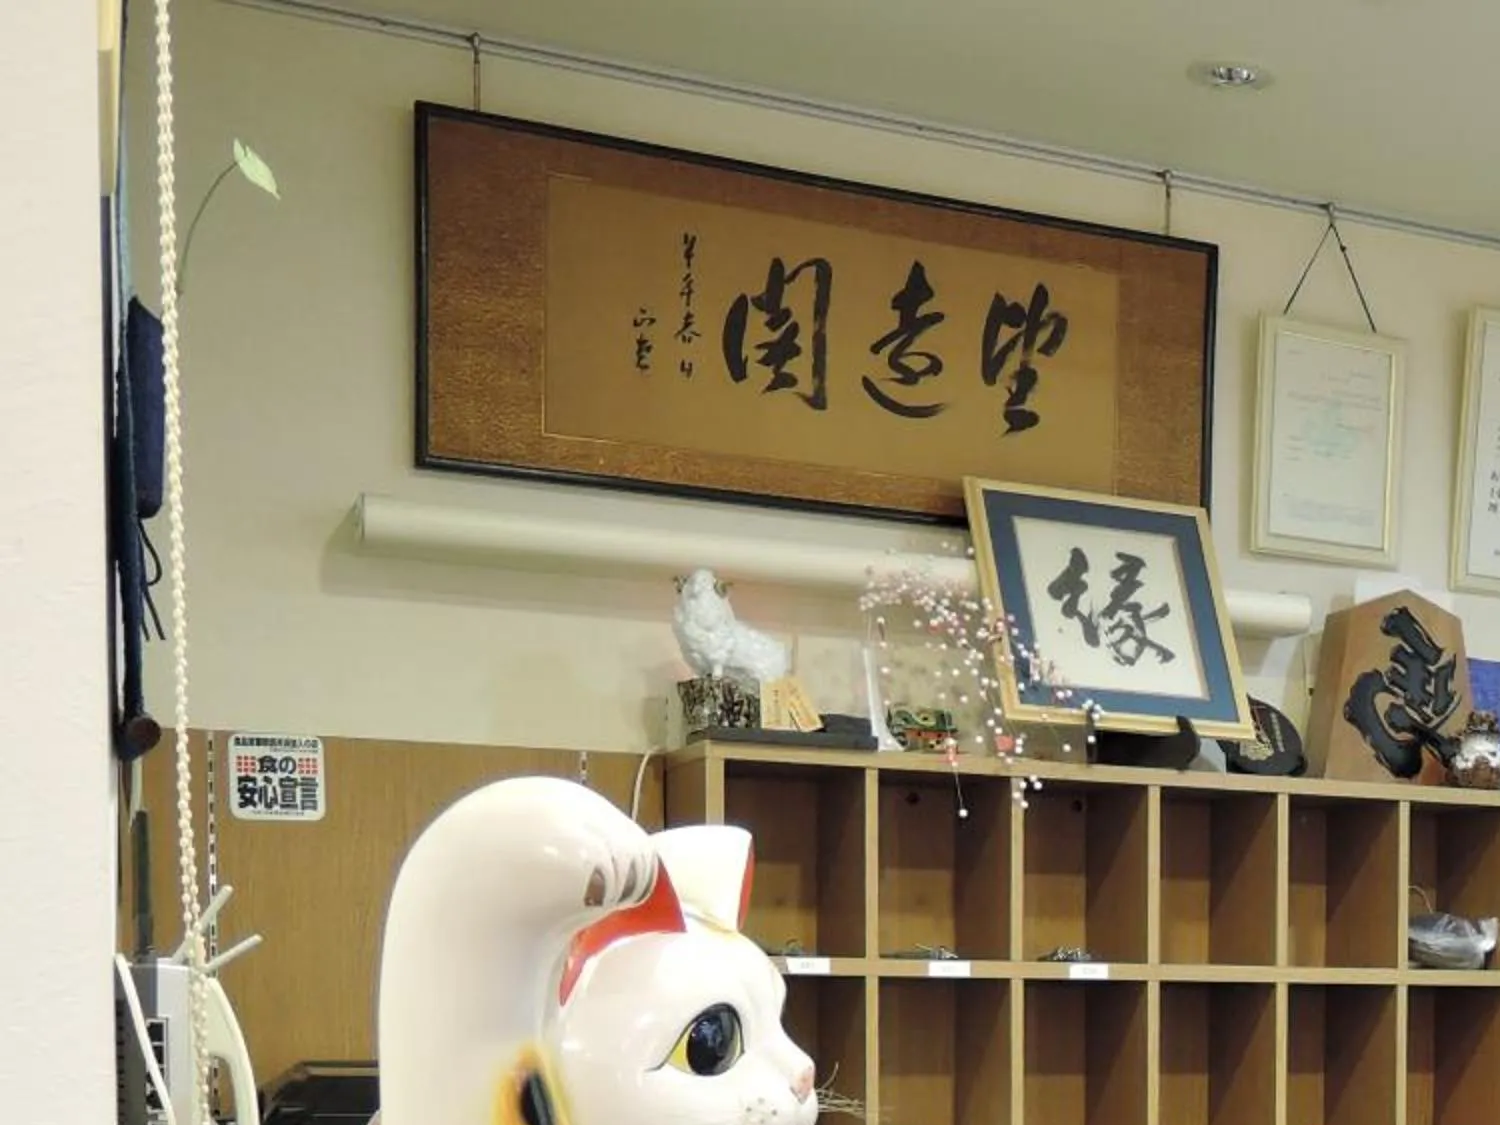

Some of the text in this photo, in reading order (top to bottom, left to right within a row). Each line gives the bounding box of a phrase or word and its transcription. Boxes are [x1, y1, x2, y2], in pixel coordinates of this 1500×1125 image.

[1046, 547, 1176, 667] 縁
[257, 755, 297, 775] 食の
[237, 774, 319, 810] 安心宣言
